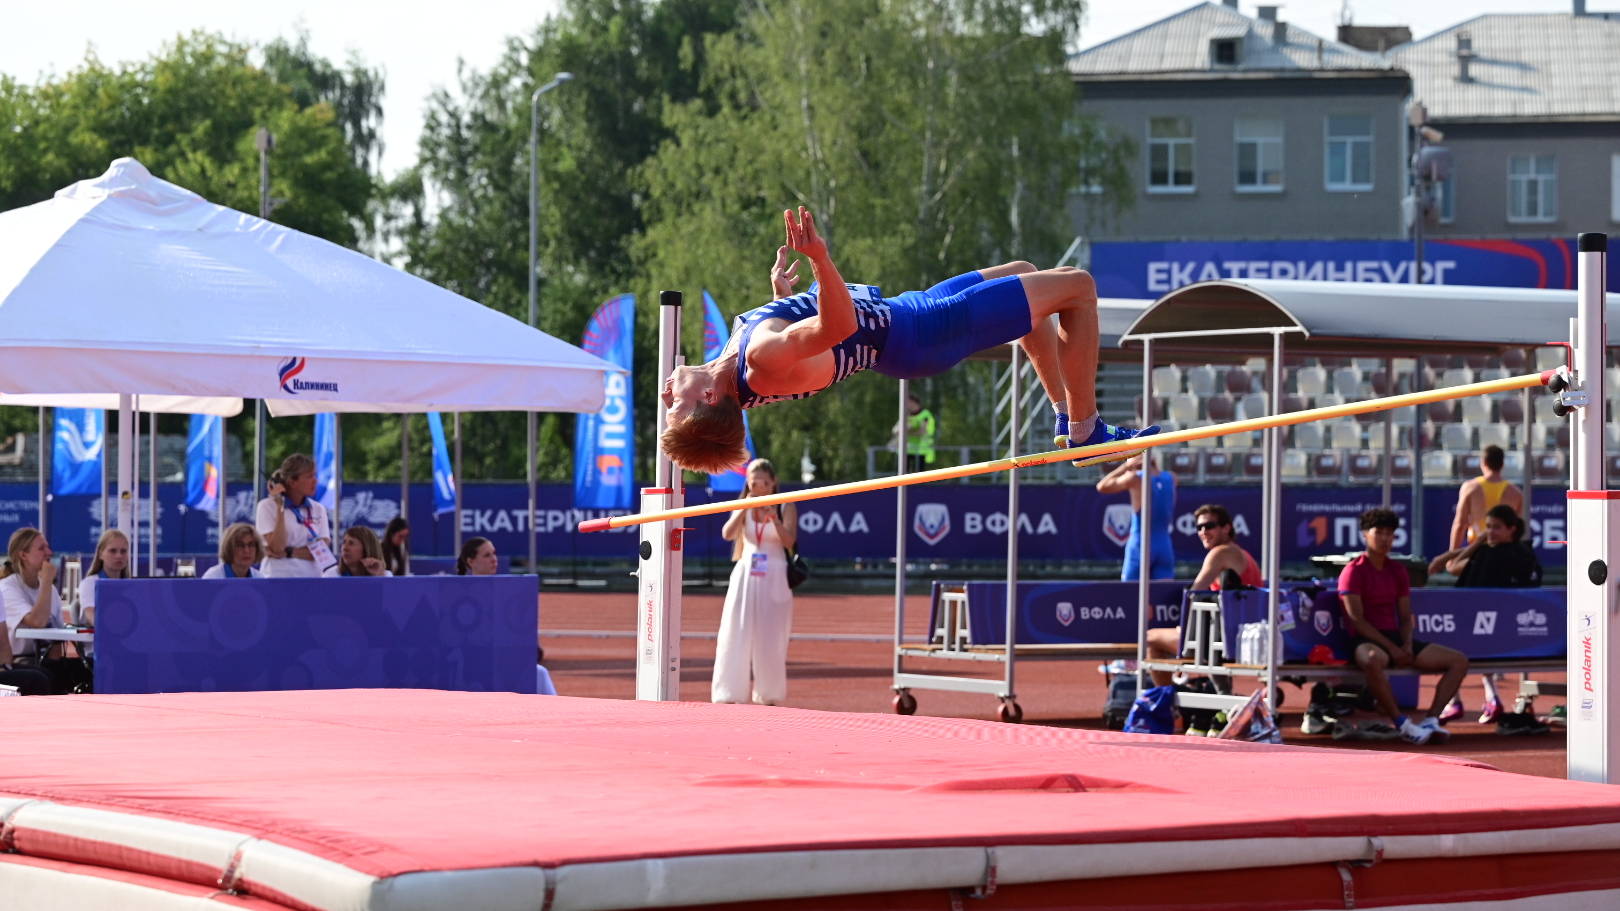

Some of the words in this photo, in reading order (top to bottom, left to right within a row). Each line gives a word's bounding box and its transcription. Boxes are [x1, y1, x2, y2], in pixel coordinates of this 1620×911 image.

[798, 511, 870, 534] ФЛА
[964, 512, 1058, 535] ВФЛА
[1080, 606, 1126, 620] ВФЛА
[1156, 605, 1180, 621] ПС
[1417, 614, 1456, 633] ПСБ
[1582, 635, 1594, 693] polanik
